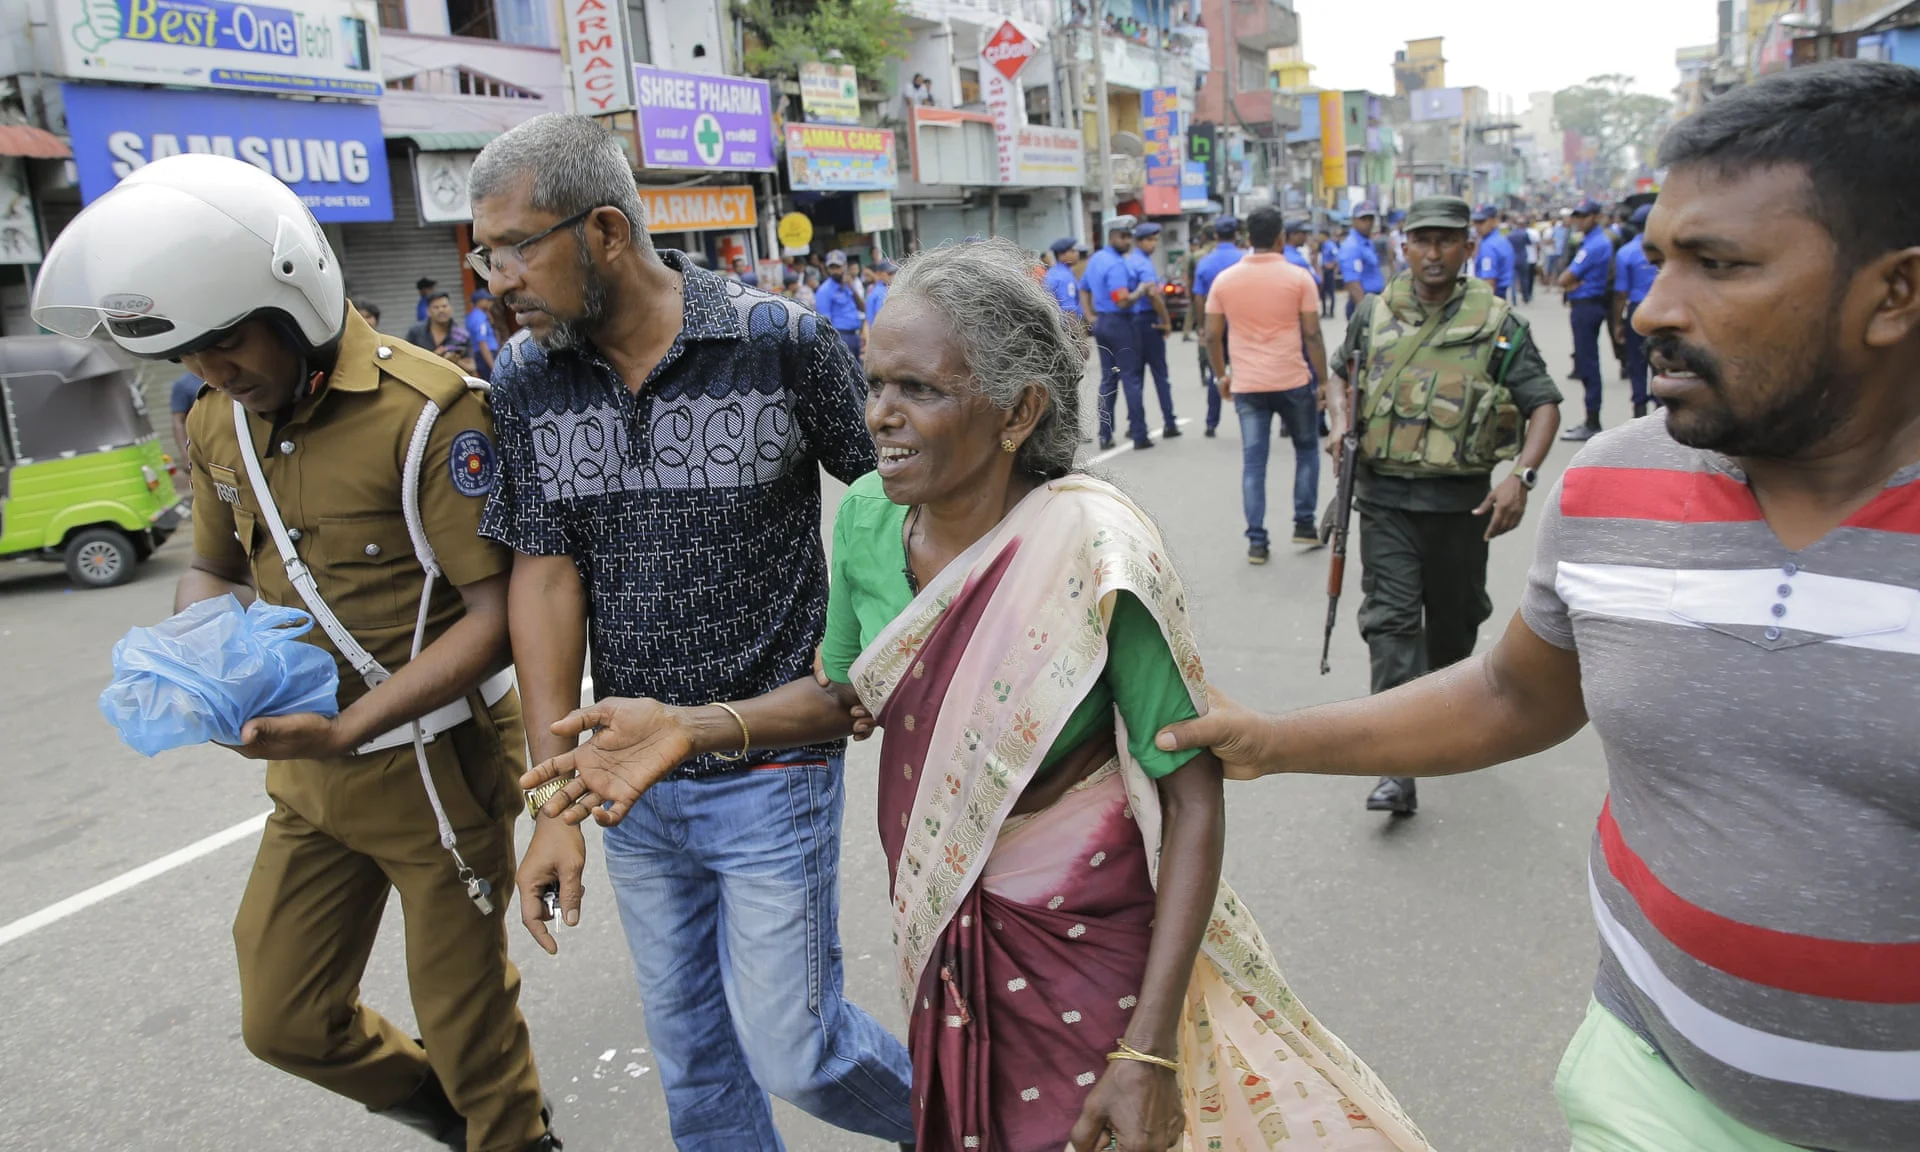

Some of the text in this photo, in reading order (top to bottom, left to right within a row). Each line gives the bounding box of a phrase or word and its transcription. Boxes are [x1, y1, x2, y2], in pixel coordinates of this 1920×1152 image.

[640, 75, 696, 110] SHREE
[699, 81, 763, 115] PHARMA
[347, 195, 371, 207] TECH
